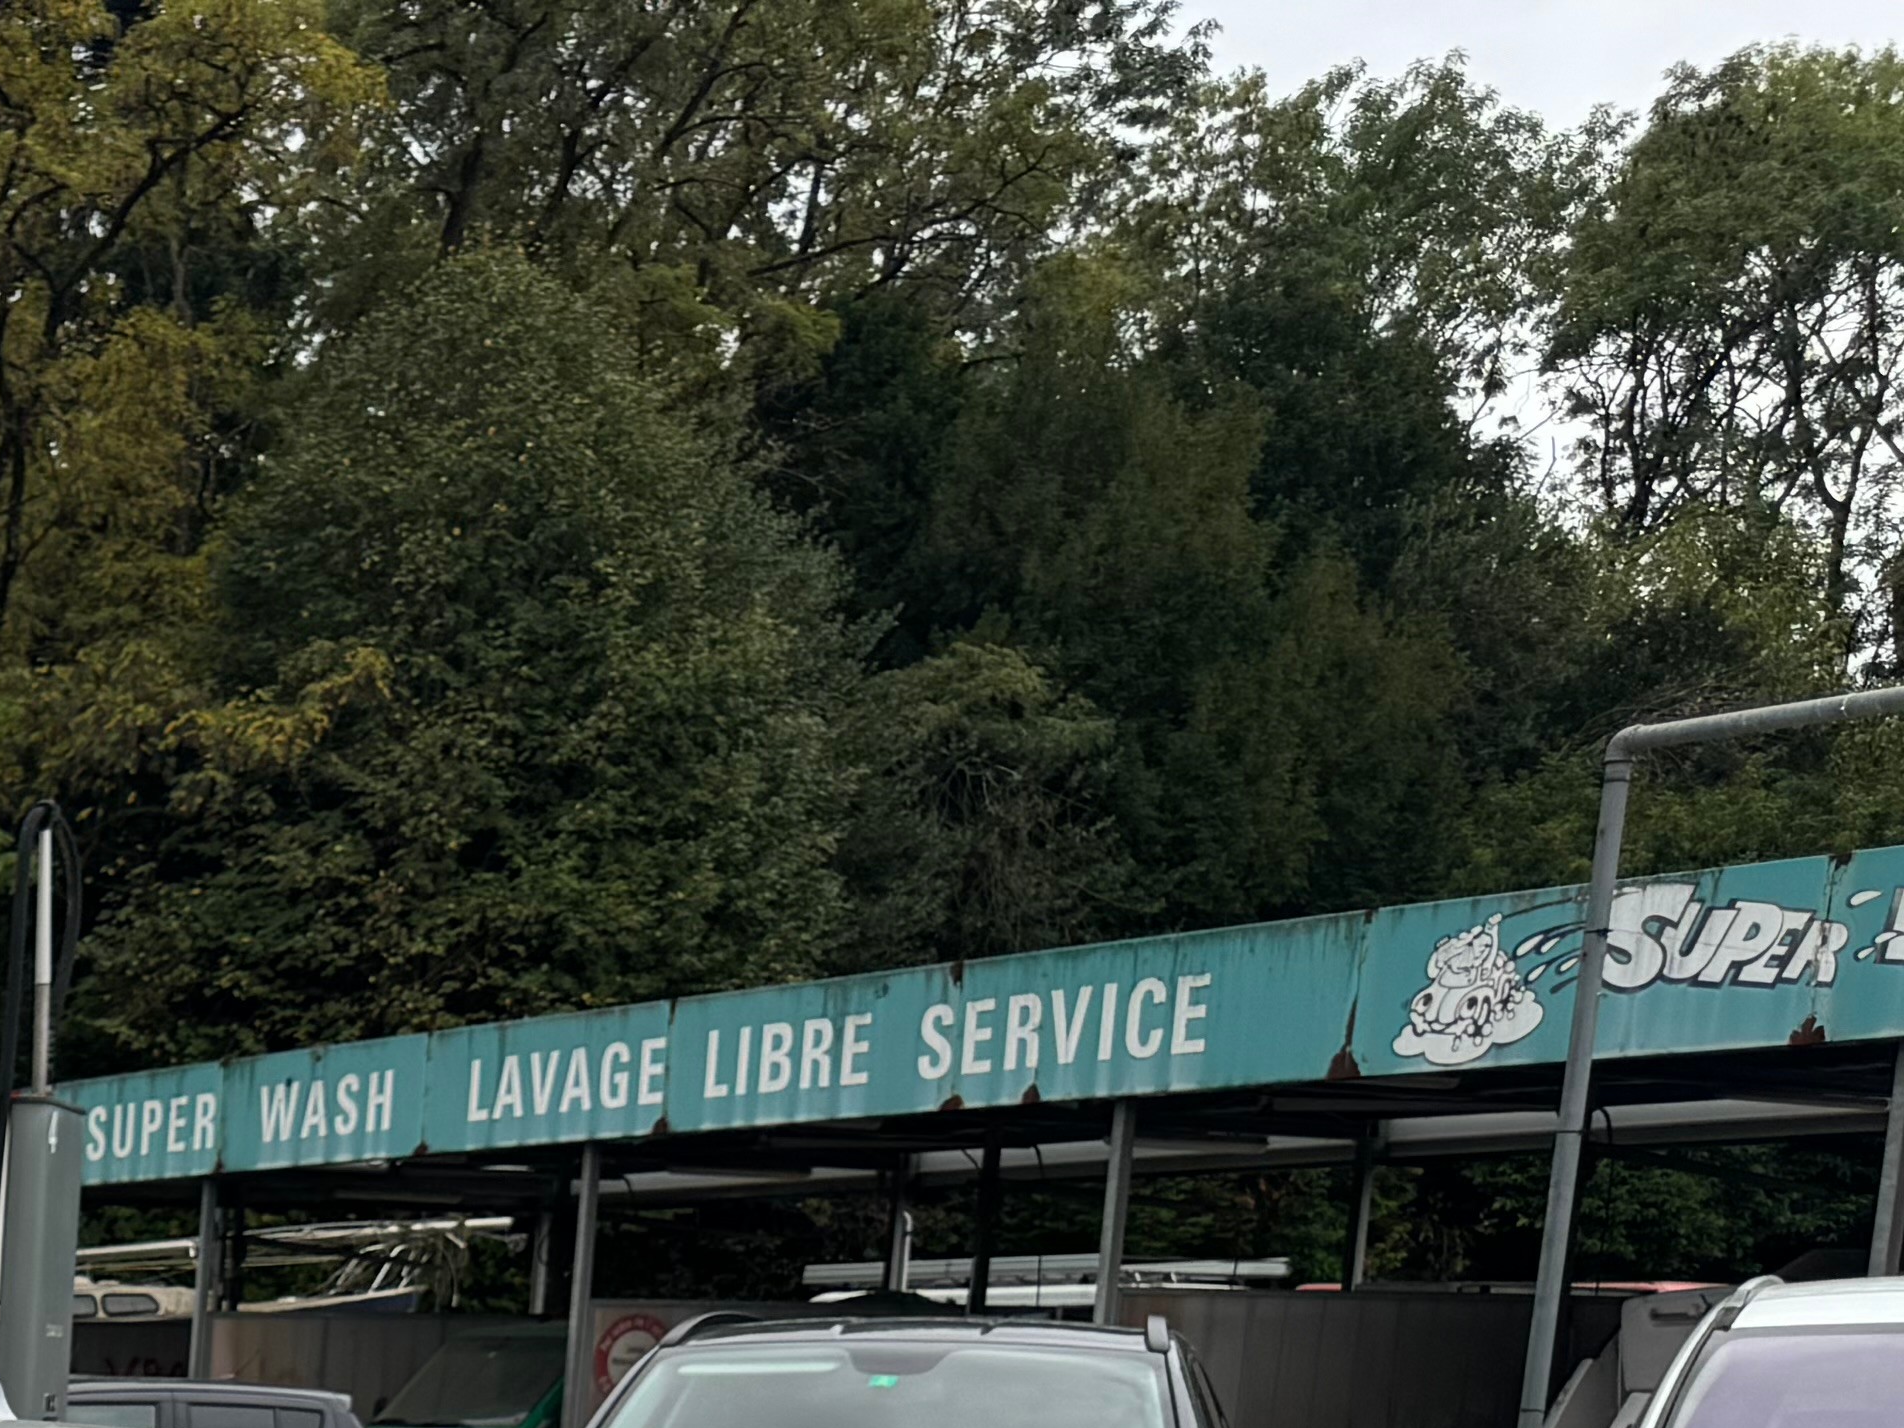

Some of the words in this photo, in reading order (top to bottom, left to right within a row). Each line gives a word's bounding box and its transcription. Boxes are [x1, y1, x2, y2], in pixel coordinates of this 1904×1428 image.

[1600, 884, 1850, 990] SUPER
[85, 1092, 217, 1162] SUPER
[260, 1068, 395, 1143] WASH
[467, 1036, 667, 1123] LAVAGE
[704, 1011, 873, 1099] LIBRE
[917, 972, 1211, 1081] SERVICE
